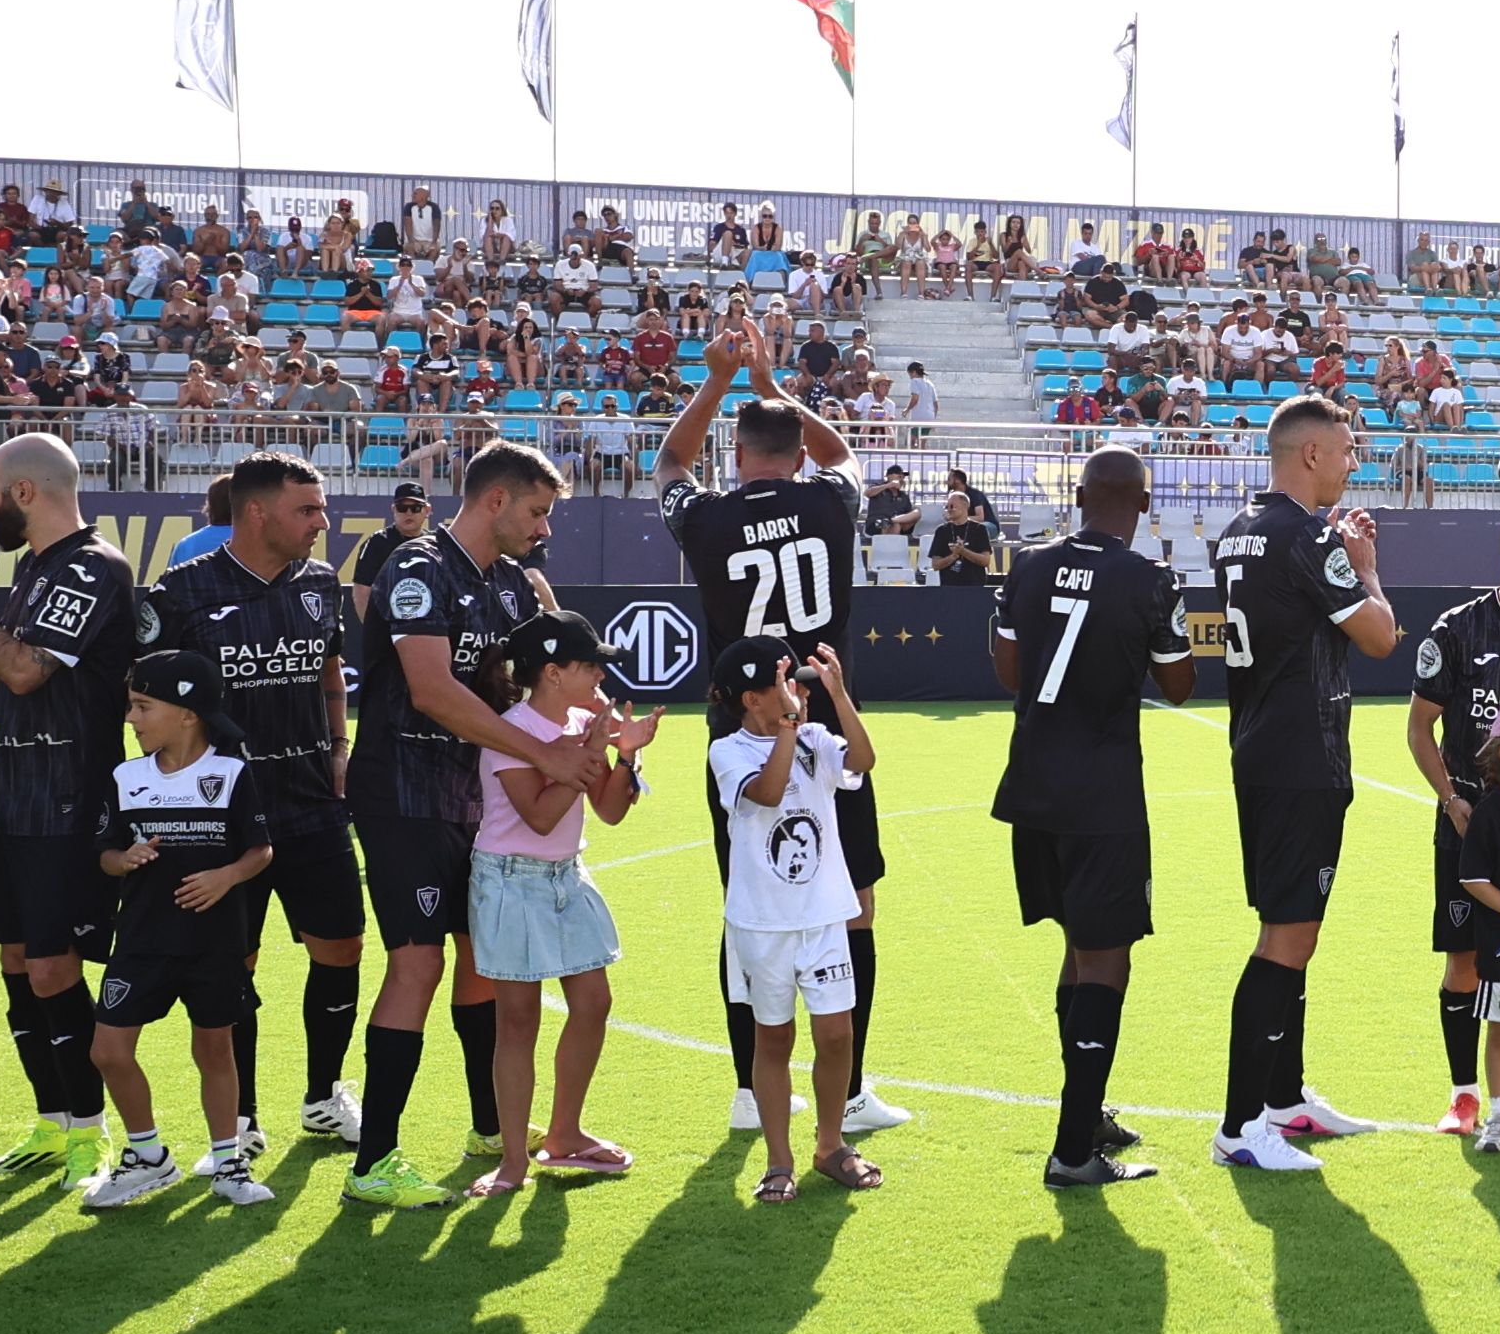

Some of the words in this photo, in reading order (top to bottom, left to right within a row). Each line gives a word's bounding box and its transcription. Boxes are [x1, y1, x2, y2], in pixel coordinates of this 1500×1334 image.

[637, 225, 675, 248] QUE
[680, 227, 707, 248] AS
[743, 515, 799, 545] BARRY
[1232, 535, 1267, 556] SANTOS
[727, 537, 833, 638] 20
[1055, 566, 1094, 591] CAFU
[56, 593, 81, 614] DA
[48, 608, 76, 628] ZN
[1225, 564, 1254, 668] 5
[220, 637, 325, 662] PALÁCIO
[613, 610, 690, 682] MG
[1037, 596, 1090, 704] 7
[221, 662, 257, 678] DO
[266, 656, 324, 674] GELO
[232, 676, 288, 689] SHOPPING
[291, 674, 319, 684] VISEU
[1470, 704, 1498, 719] DO
[163, 794, 195, 803] LEGADO
[141, 821, 227, 833] TERROSILVARES
